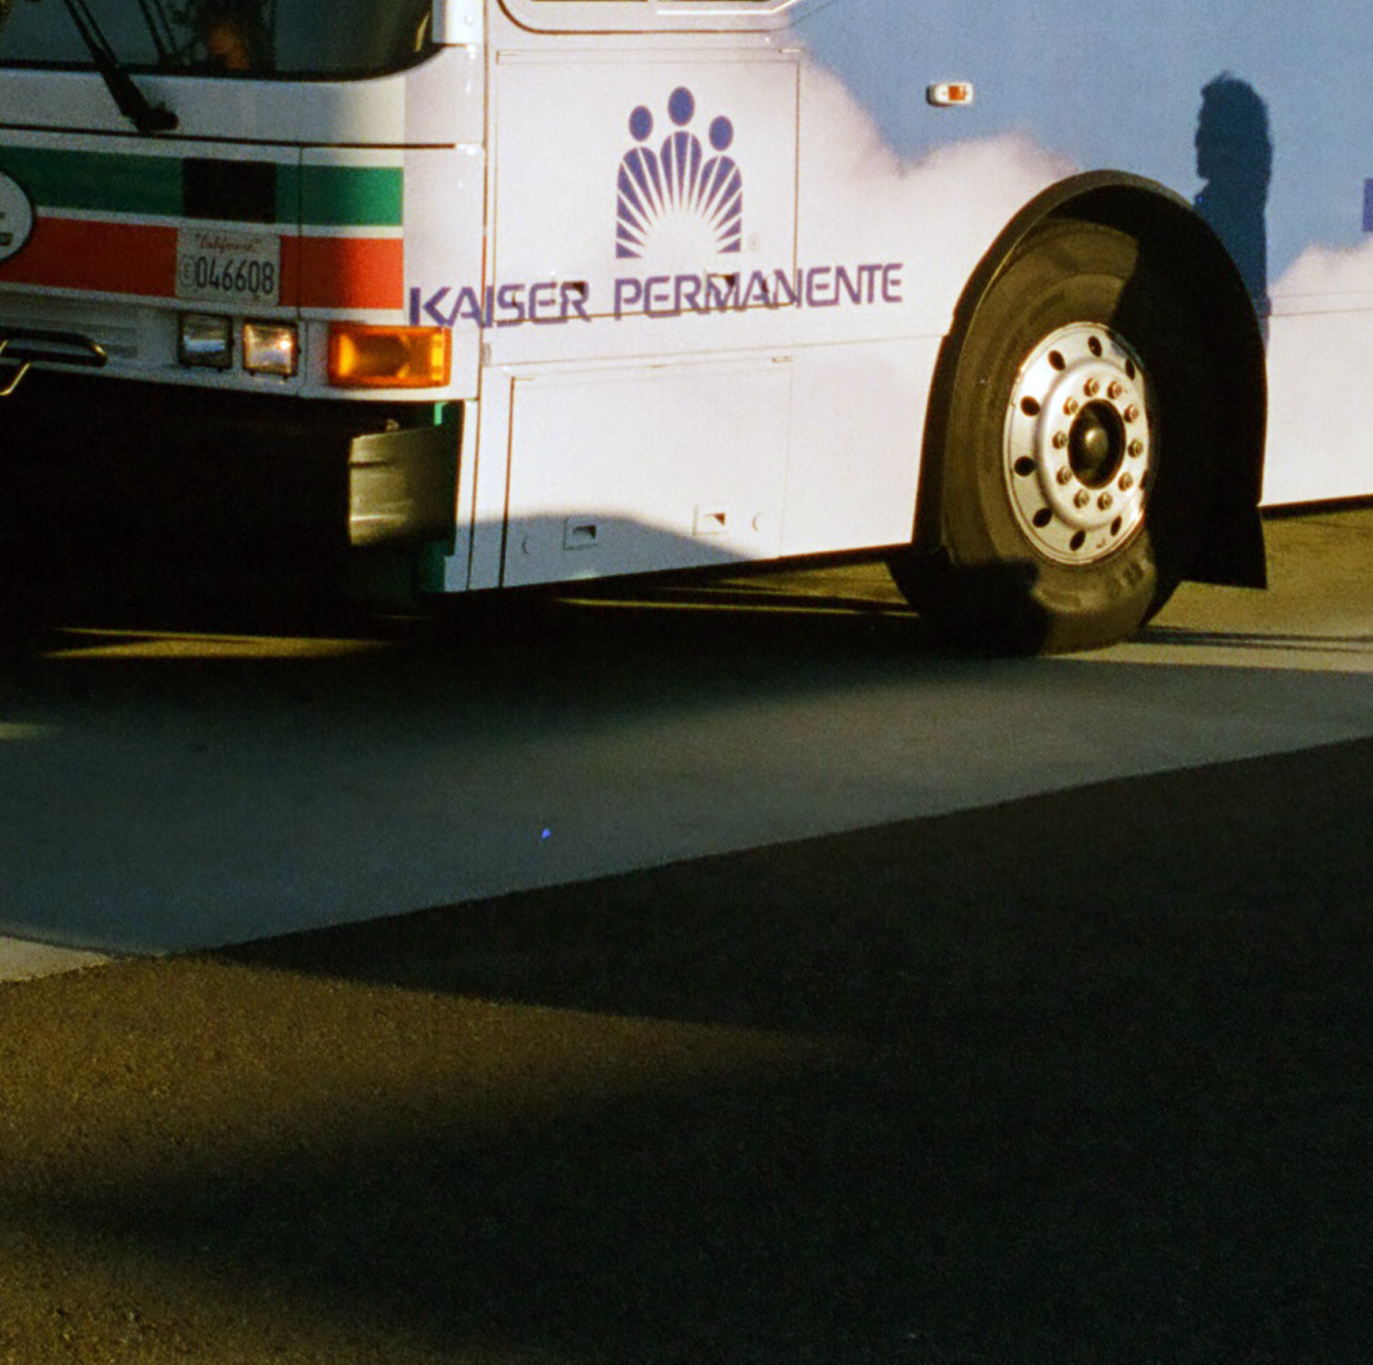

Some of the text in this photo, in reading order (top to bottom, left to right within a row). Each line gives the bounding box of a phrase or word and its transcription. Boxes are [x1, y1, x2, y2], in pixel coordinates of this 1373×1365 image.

[196, 256, 275, 295] 046608
[409, 262, 905, 329] KAISER PERMANENTE
